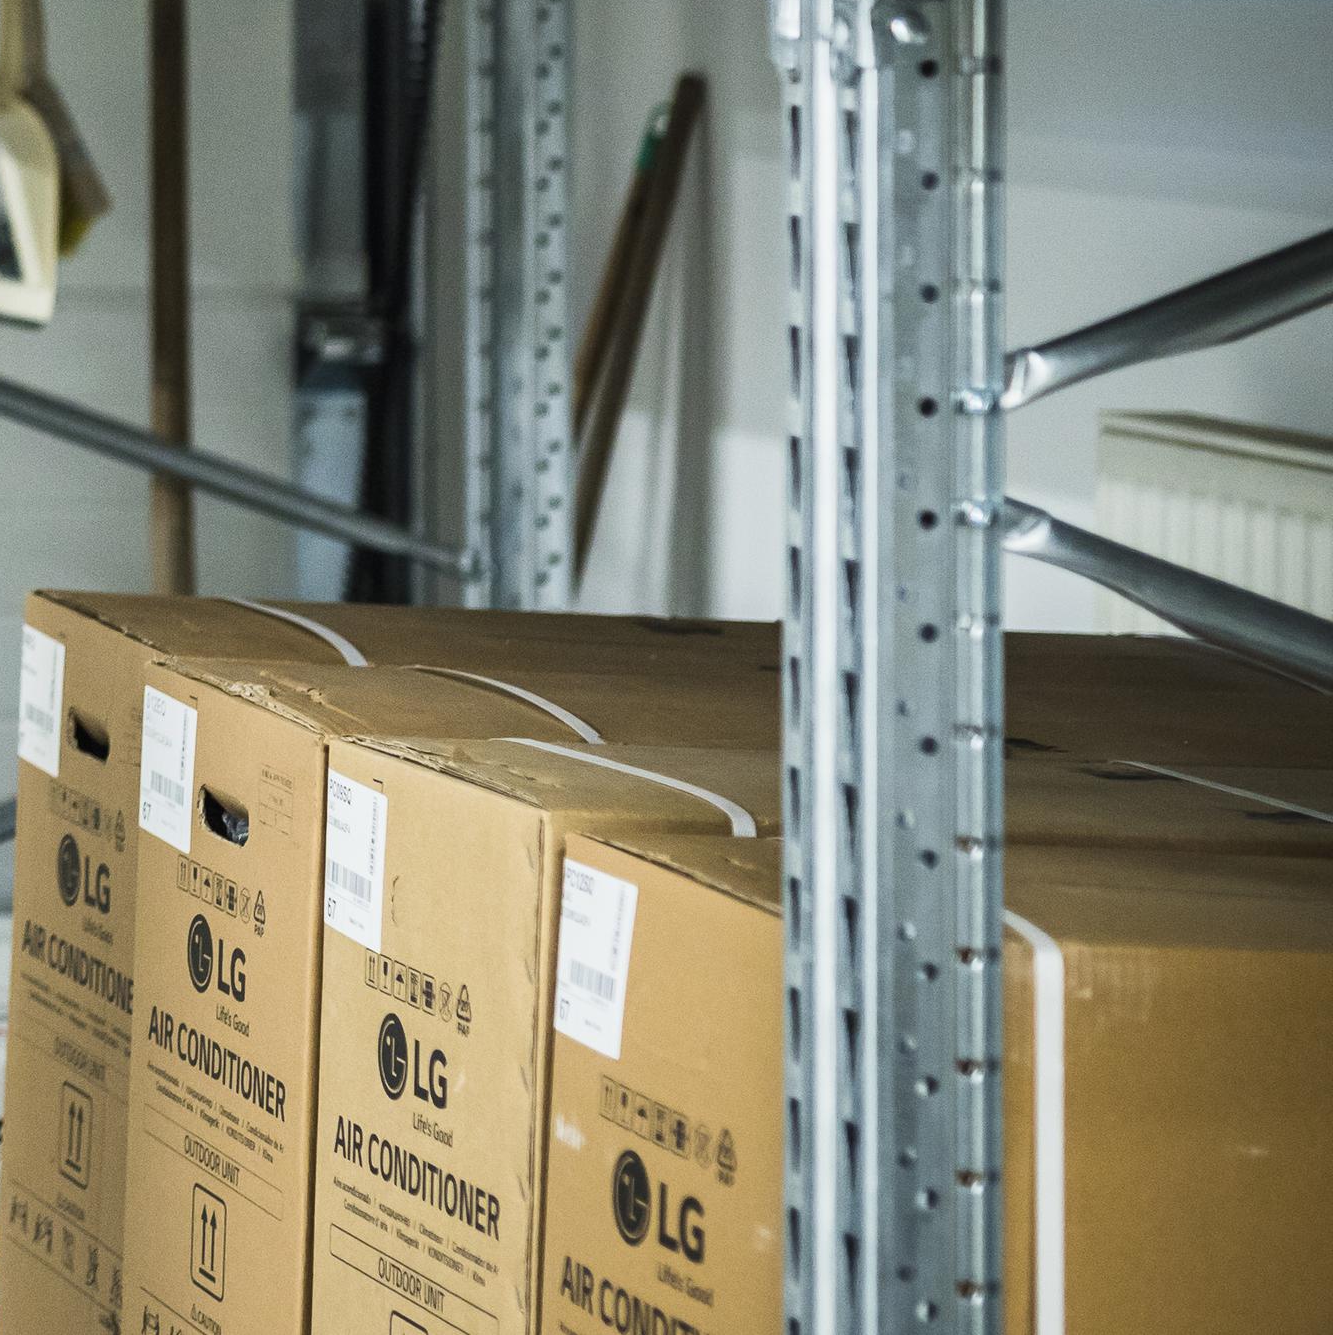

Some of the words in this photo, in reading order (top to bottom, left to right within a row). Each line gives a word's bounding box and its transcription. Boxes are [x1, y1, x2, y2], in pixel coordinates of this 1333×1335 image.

[85, 855, 111, 914] LG
[21, 919, 47, 965] AIR
[47, 933, 134, 1016] CONDITIONE
[217, 938, 246, 1003] LG
[148, 1005, 174, 1053] AIR
[177, 1022, 286, 1123] CONDITIONER
[413, 1038, 448, 1109] LG
[412, 1112, 432, 1137] Life's
[184, 1134, 221, 1175] OUTDOOR
[221, 1160, 240, 1187] UNIT
[334, 1115, 364, 1168] AIR
[368, 1133, 501, 1241] CONDITIONER
[658, 1181, 706, 1264] LG
[378, 1256, 422, 1300] OUTDOOR
[423, 1284, 446, 1314] UNIT
[560, 1255, 595, 1316] AIR
